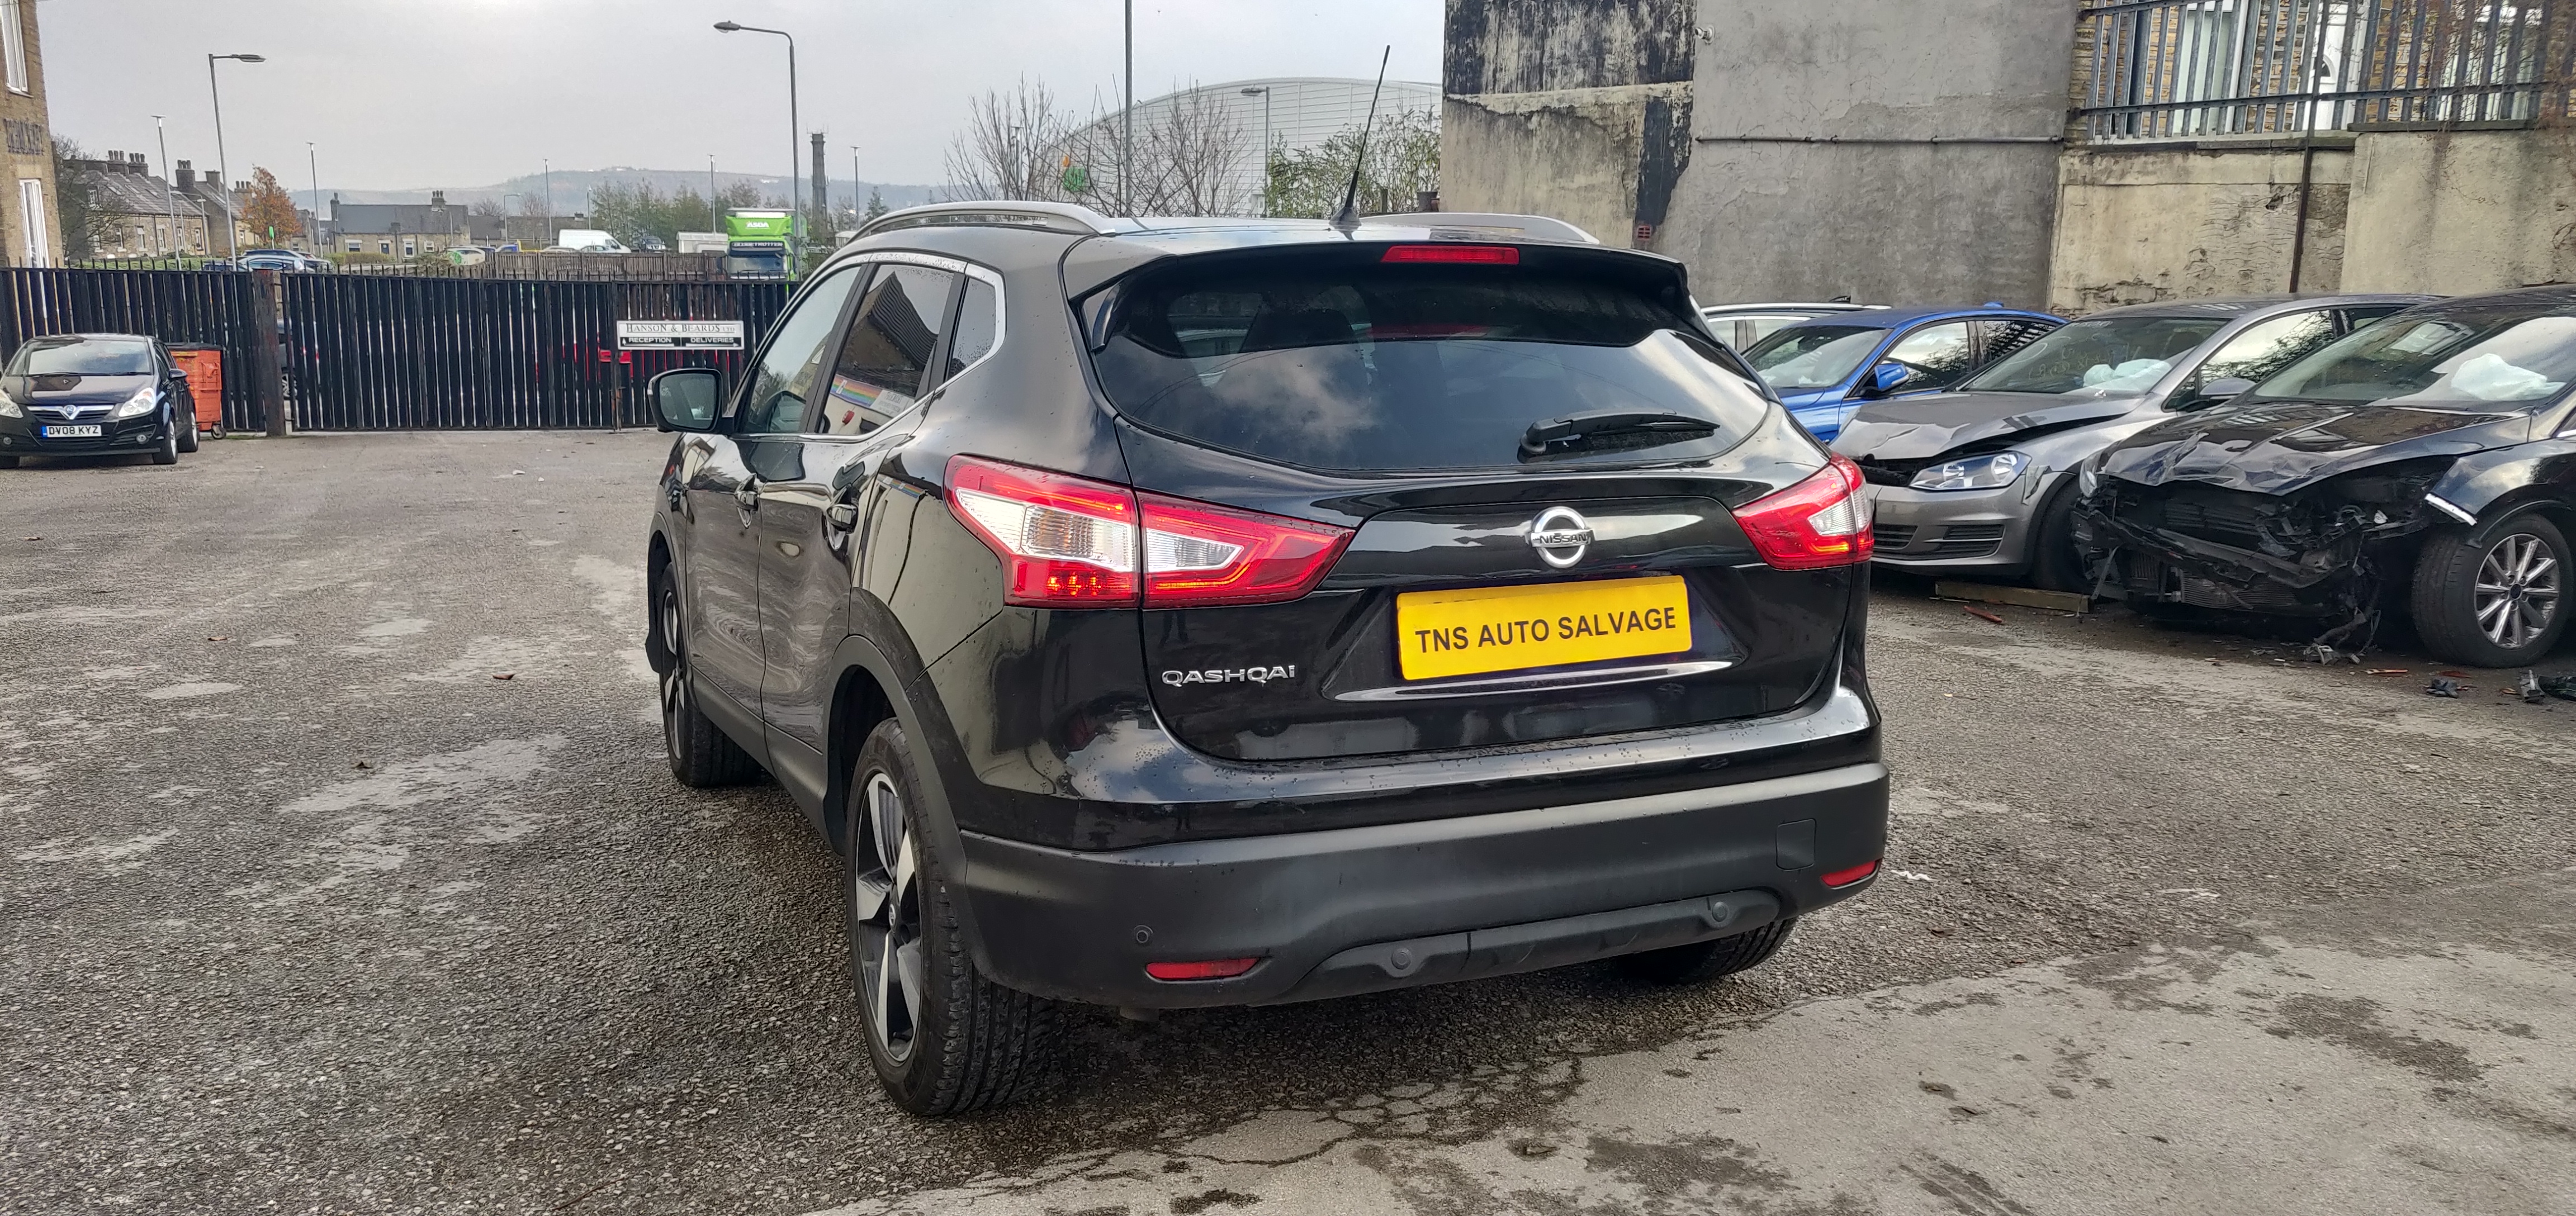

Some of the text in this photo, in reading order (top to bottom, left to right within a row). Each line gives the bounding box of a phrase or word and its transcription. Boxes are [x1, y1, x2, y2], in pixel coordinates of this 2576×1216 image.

[627, 324, 667, 332] HANSON
[681, 324, 721, 332] BEARDS
[49, 426, 99, 435] DV08 KYZ
[1539, 534, 1587, 544] NISSAN
[1415, 607, 1677, 653] TNS AUTO SALVAGE
[1161, 664, 1295, 687] QASHQAI
